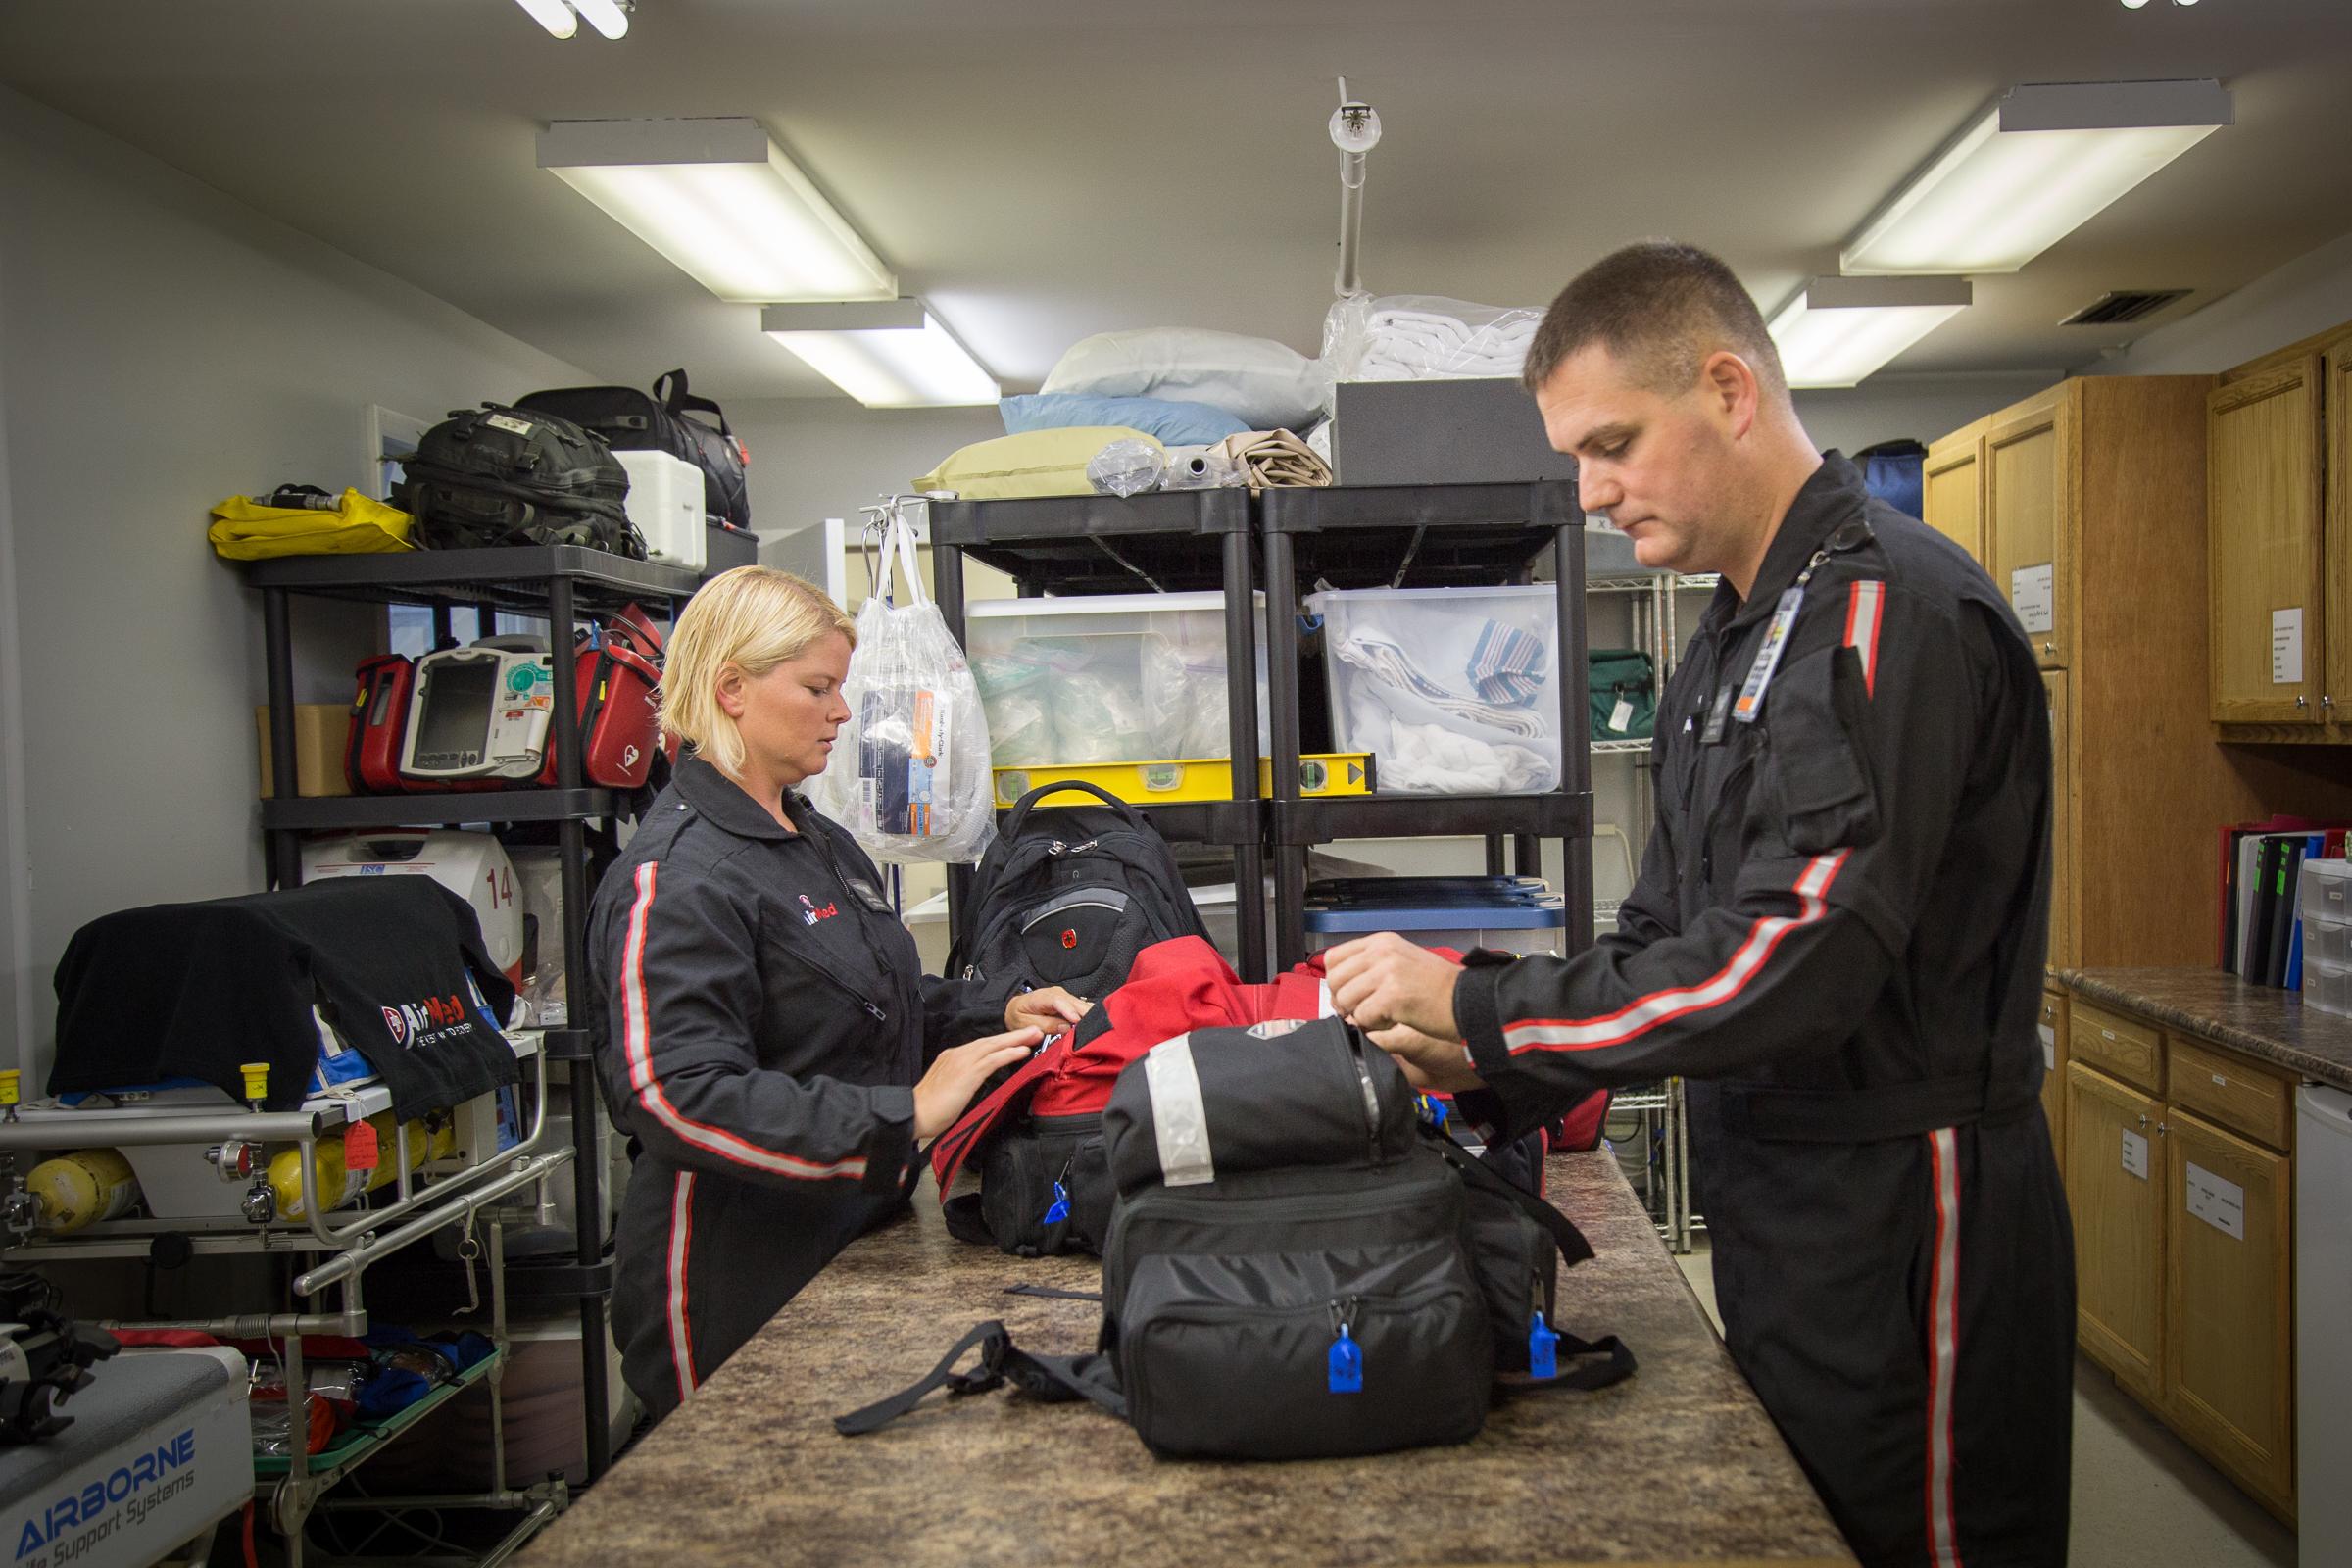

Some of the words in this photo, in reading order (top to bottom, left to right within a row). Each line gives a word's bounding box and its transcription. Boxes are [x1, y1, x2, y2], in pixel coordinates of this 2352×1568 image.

[487, 866, 513, 909] 14
[400, 994, 465, 1044] AirMed
[15, 1427, 196, 1561] AIRBORNE
[53, 1509, 122, 1568] Support
[126, 1469, 195, 1526] Systems
